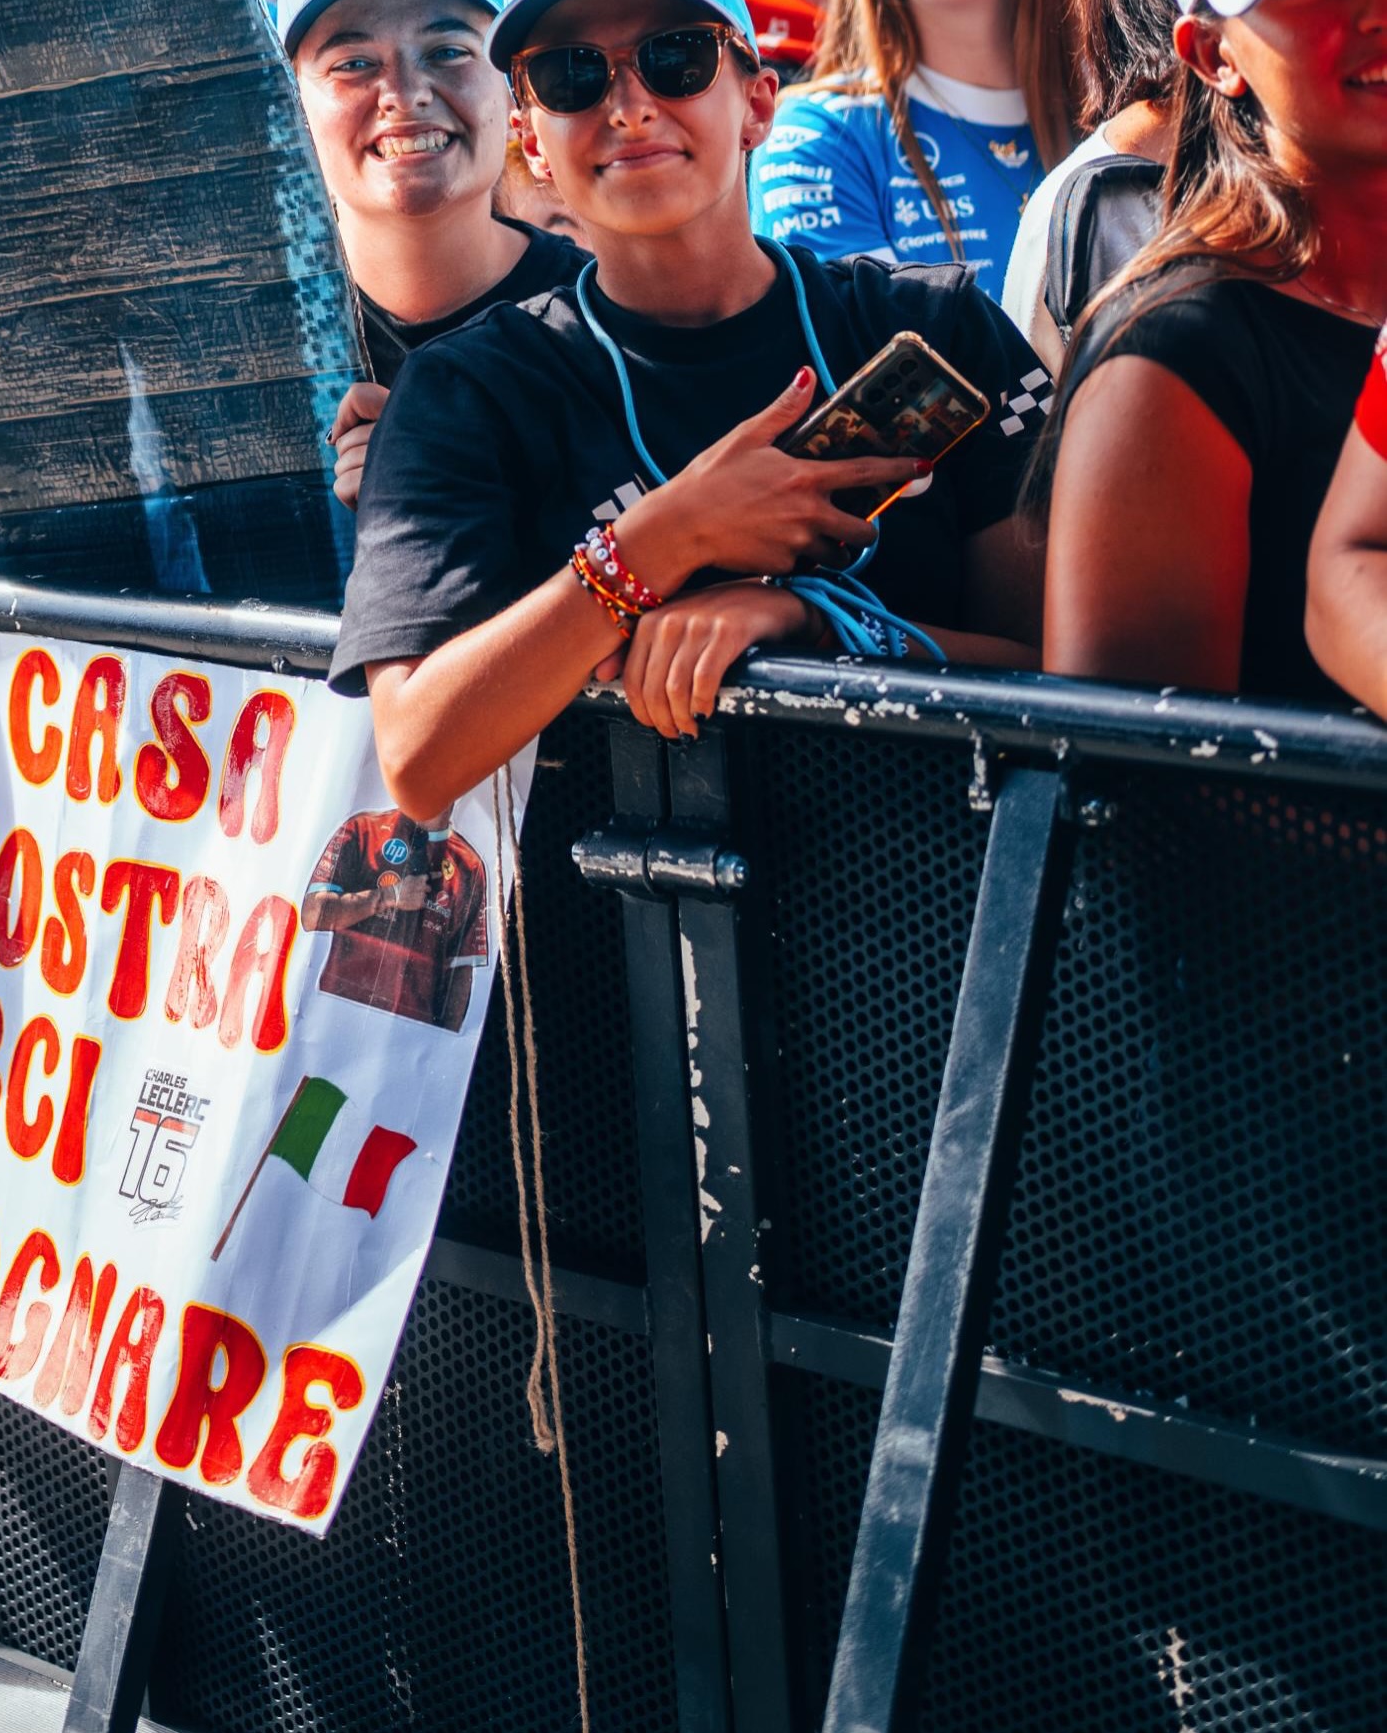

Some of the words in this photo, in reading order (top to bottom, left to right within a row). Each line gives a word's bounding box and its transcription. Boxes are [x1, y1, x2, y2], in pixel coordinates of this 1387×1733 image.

[773, 212, 818, 239] AMD
[9, 647, 296, 845] CASA
[385, 839, 406, 864] hp
[145, 1068, 188, 1090] CHARLES
[138, 1081, 211, 1121] LECLERC
[119, 1106, 200, 1208] 16
